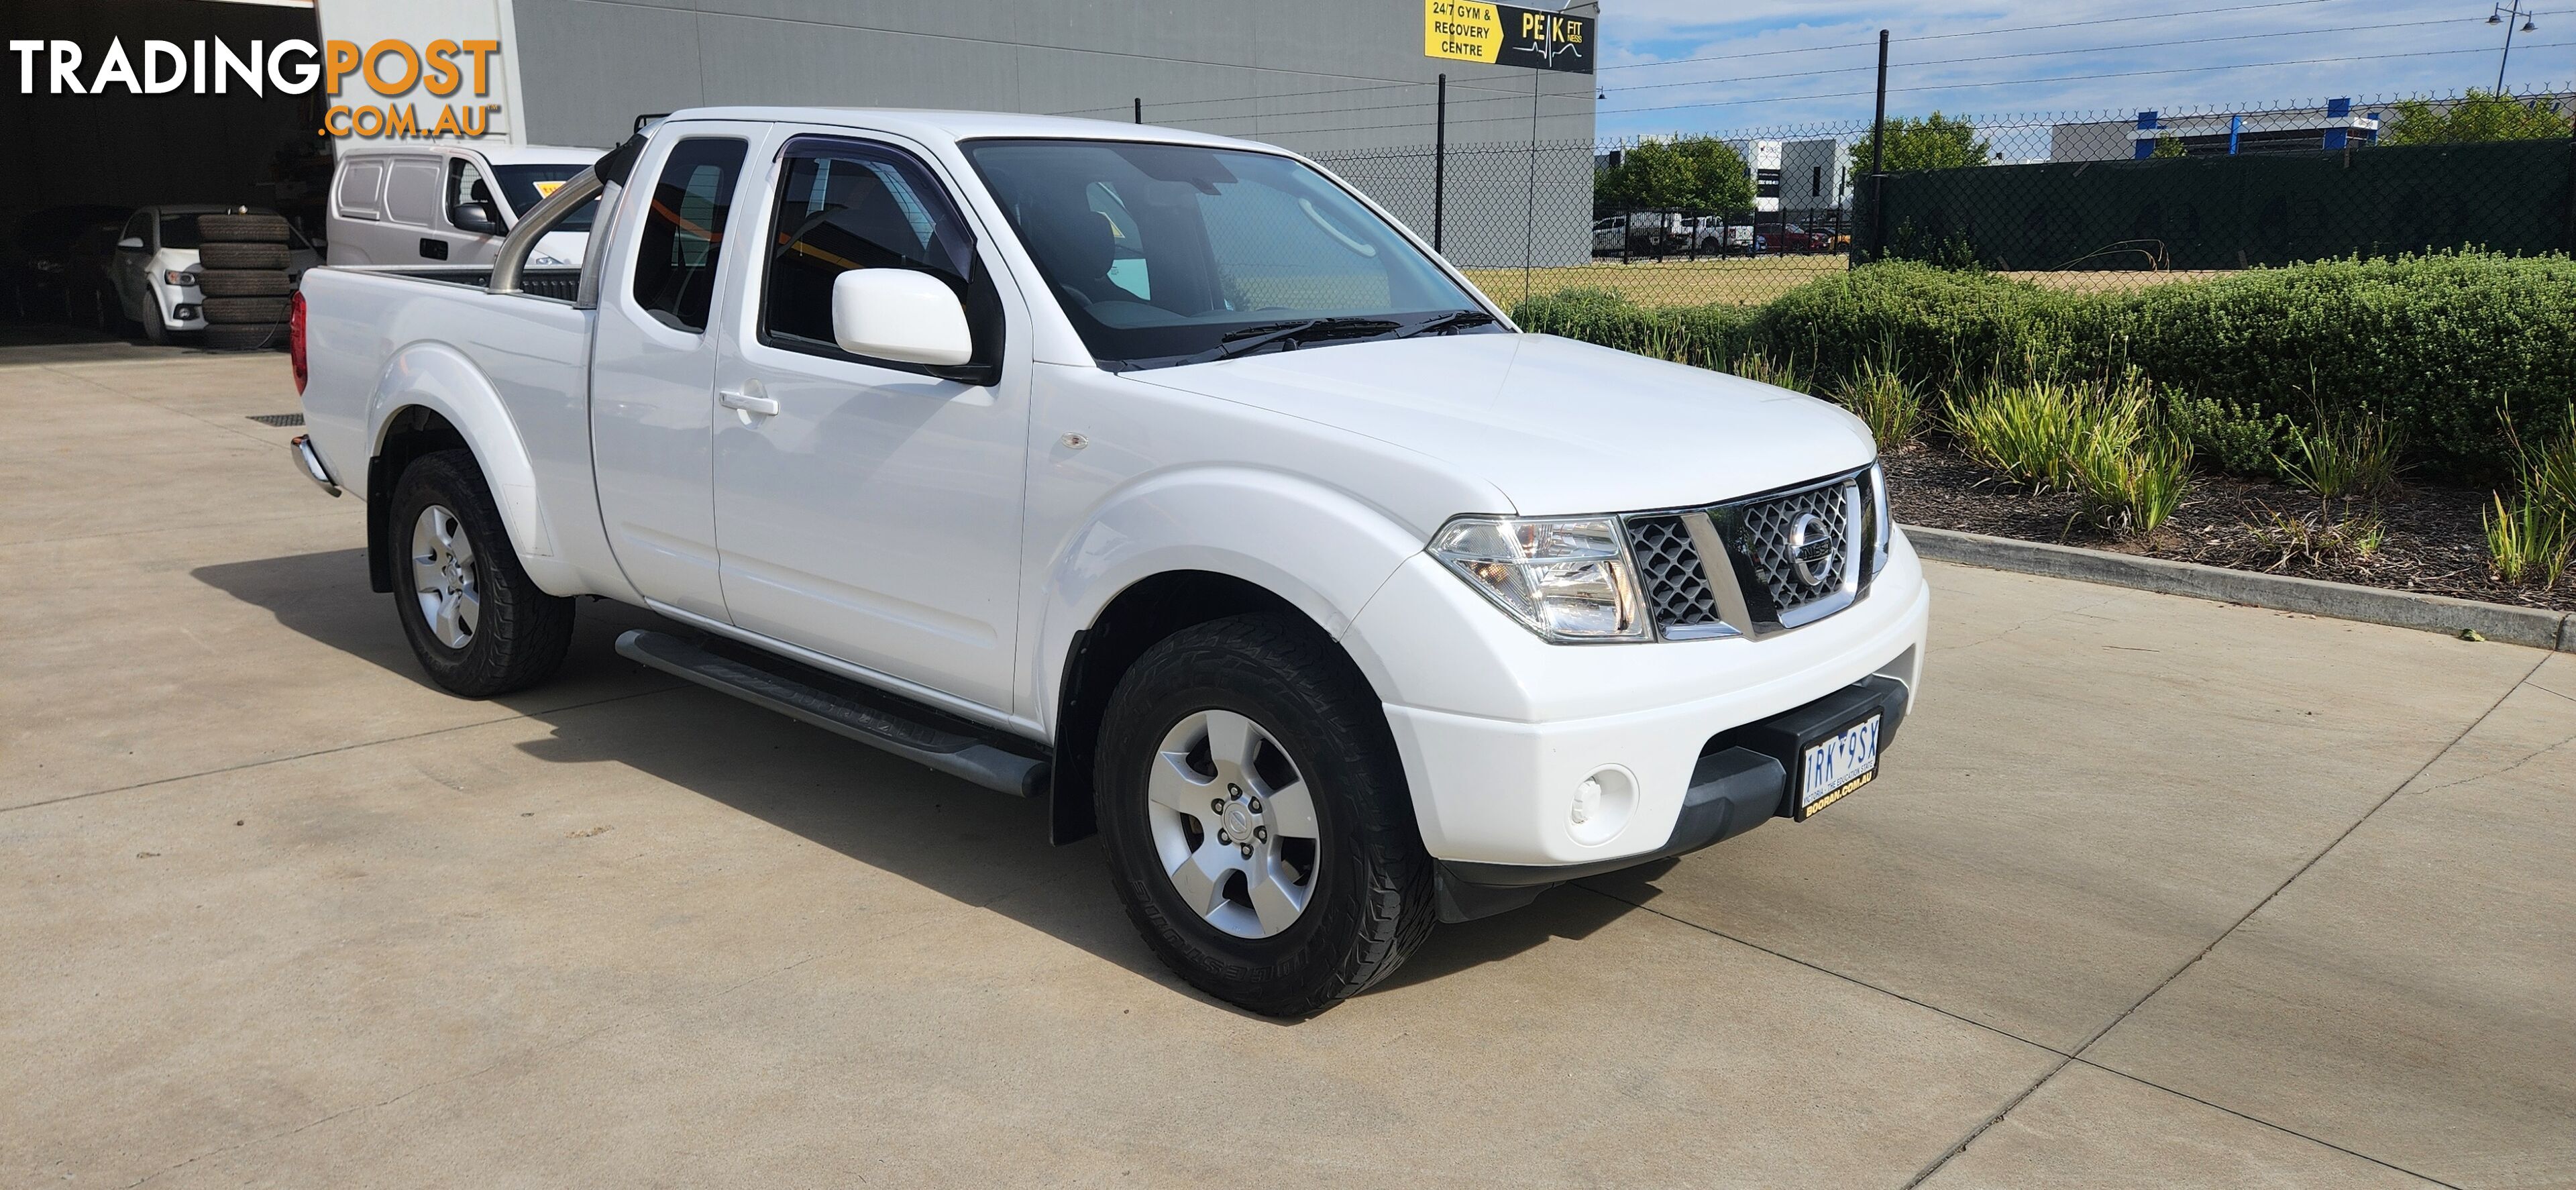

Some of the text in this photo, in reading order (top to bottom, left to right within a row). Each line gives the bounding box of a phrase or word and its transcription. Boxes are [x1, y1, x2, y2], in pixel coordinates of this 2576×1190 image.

[1433, 1, 1491, 21] 24/7 GYM &
[1434, 21, 1489, 39] RECOVERY
[1567, 20, 1582, 36] FIT
[1442, 40, 1482, 56] CENTRE
[1567, 34, 1582, 44] NESS
[1807, 720, 1878, 793] 1RK 9SX
[1803, 788, 1823, 805] VICTORIA
[1827, 780, 1836, 791] THE
[1837, 767, 1860, 787] EDUCATION
[1860, 760, 1874, 773] STATE
[1806, 771, 1872, 817] BOORAN.COM.AU
